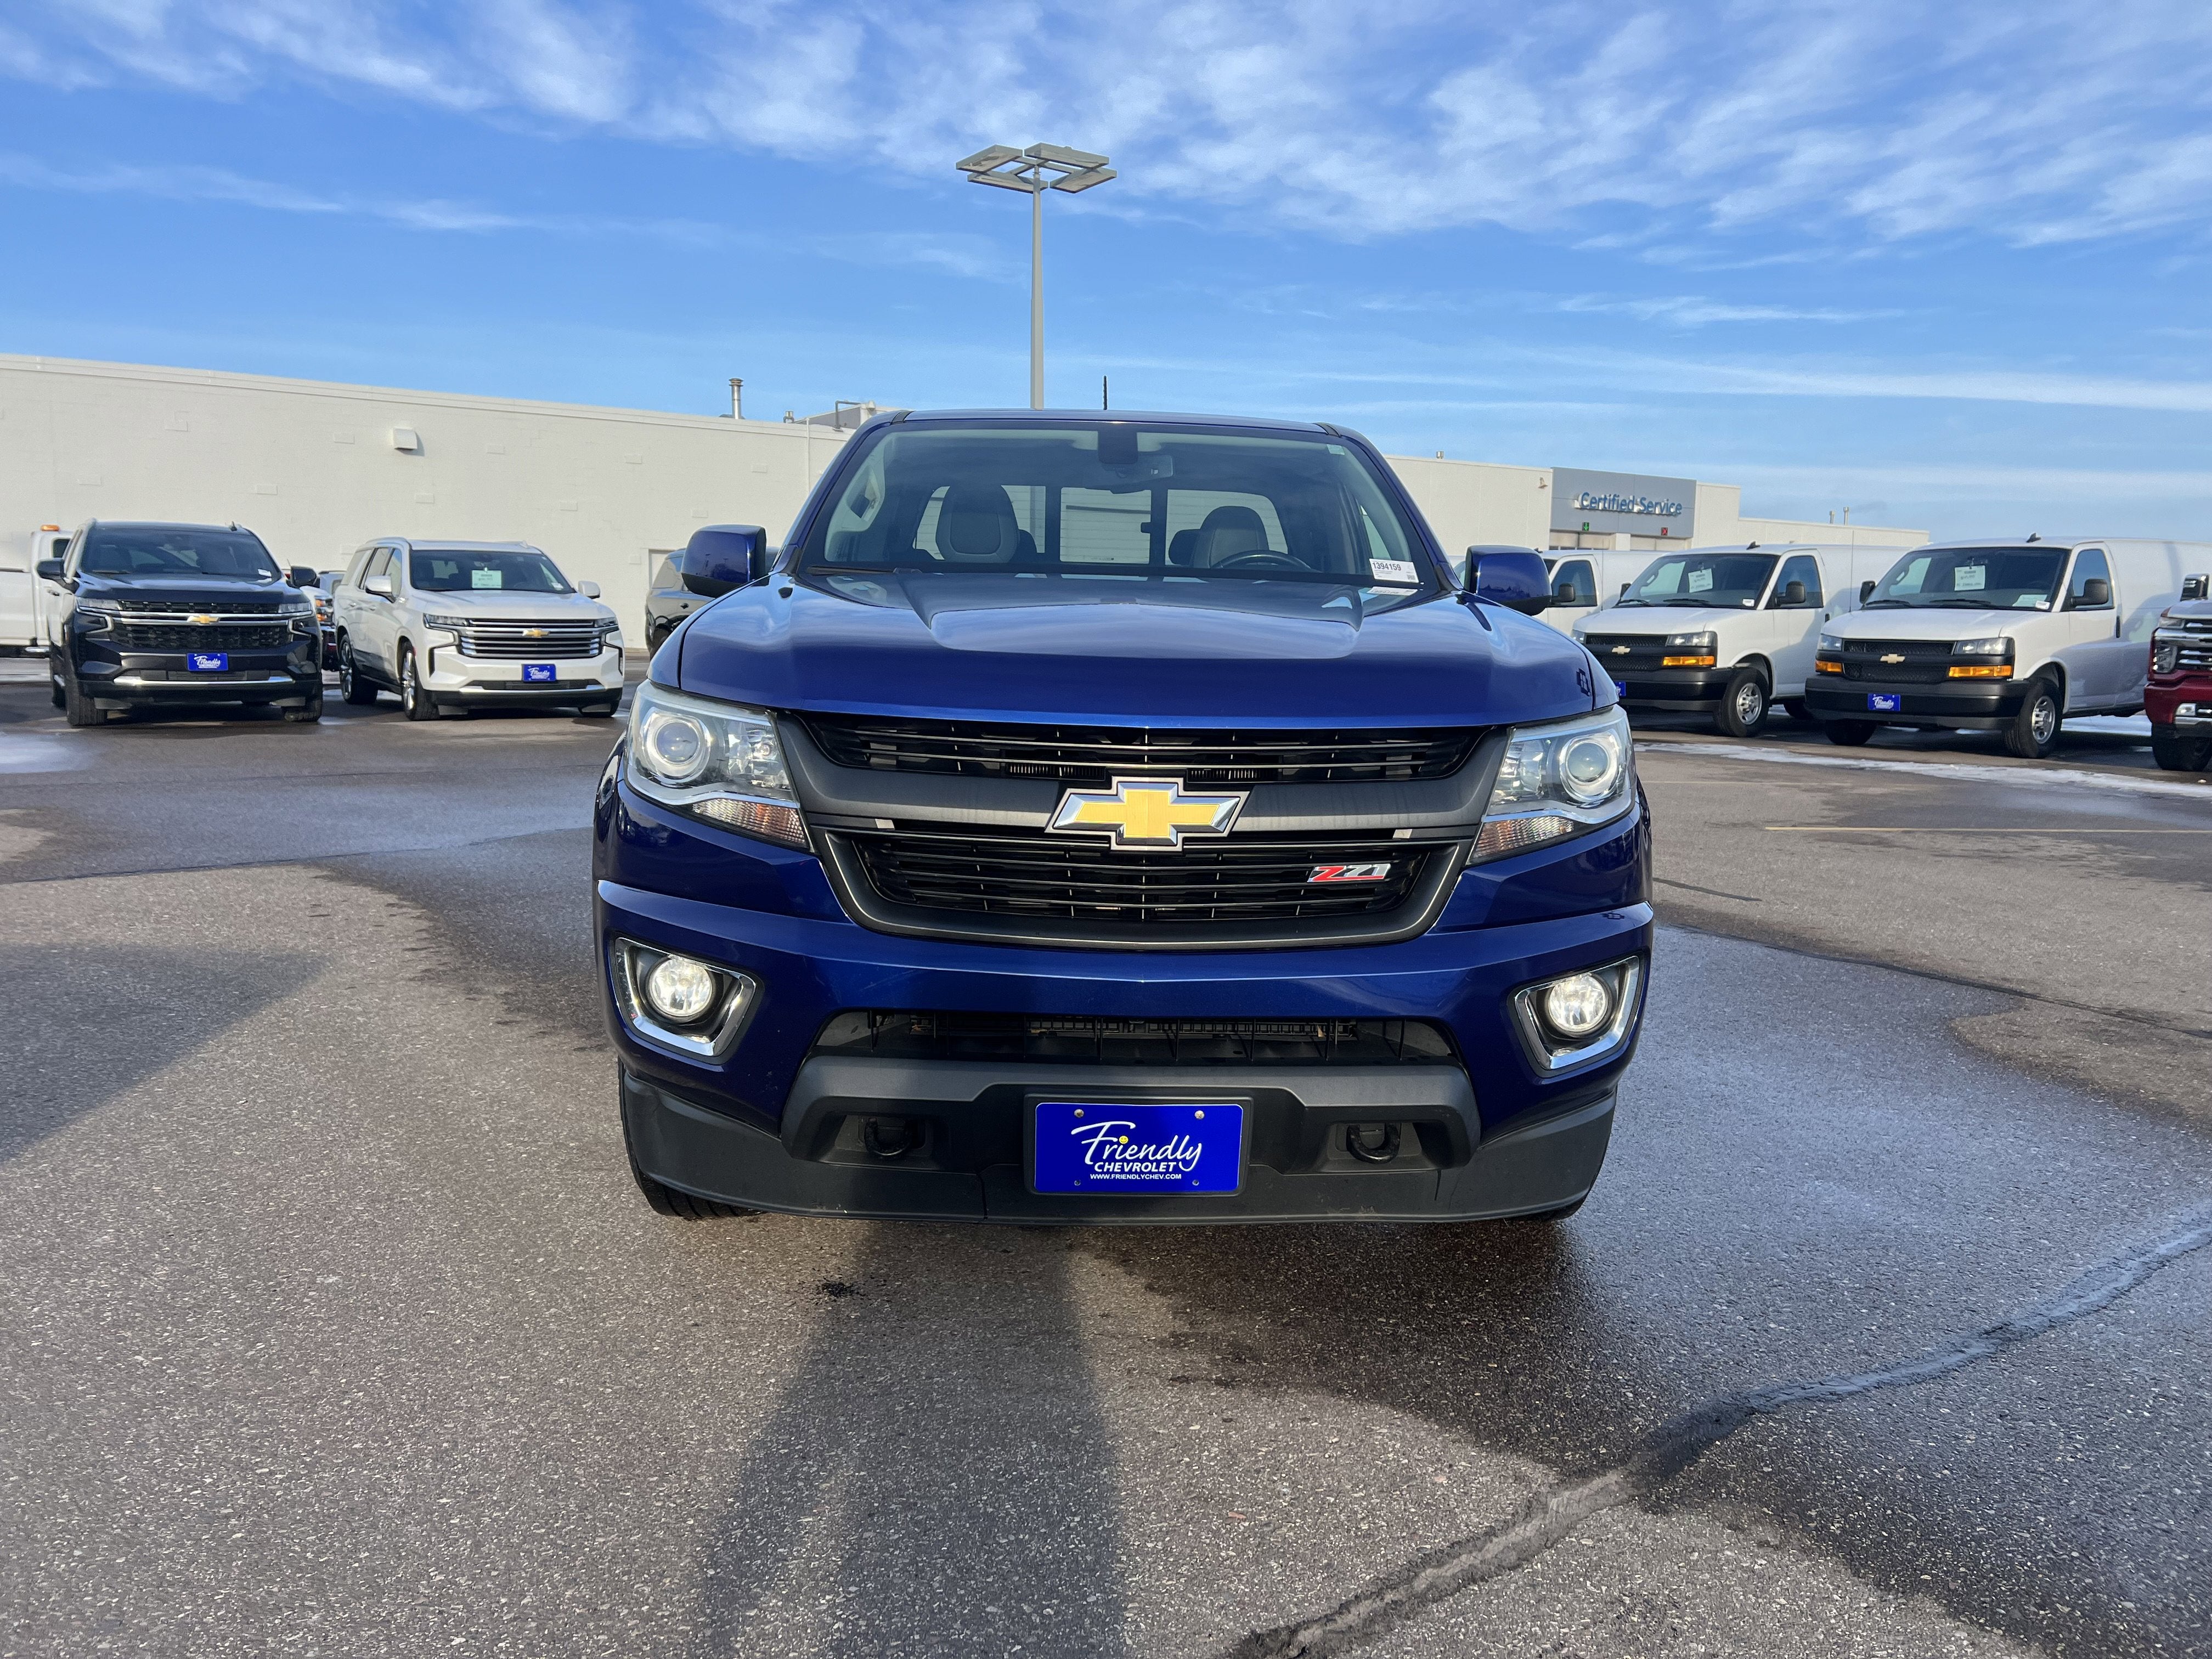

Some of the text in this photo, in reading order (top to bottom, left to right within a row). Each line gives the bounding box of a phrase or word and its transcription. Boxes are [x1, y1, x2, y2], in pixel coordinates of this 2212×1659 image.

[1579, 492, 1682, 515] Certified Service
[1373, 562, 1401, 571] 1394159
[1307, 863, 1391, 882] Z71
[1071, 1121, 1202, 1171] Friendly
[1094, 1161, 1176, 1172] CHEVROLET
